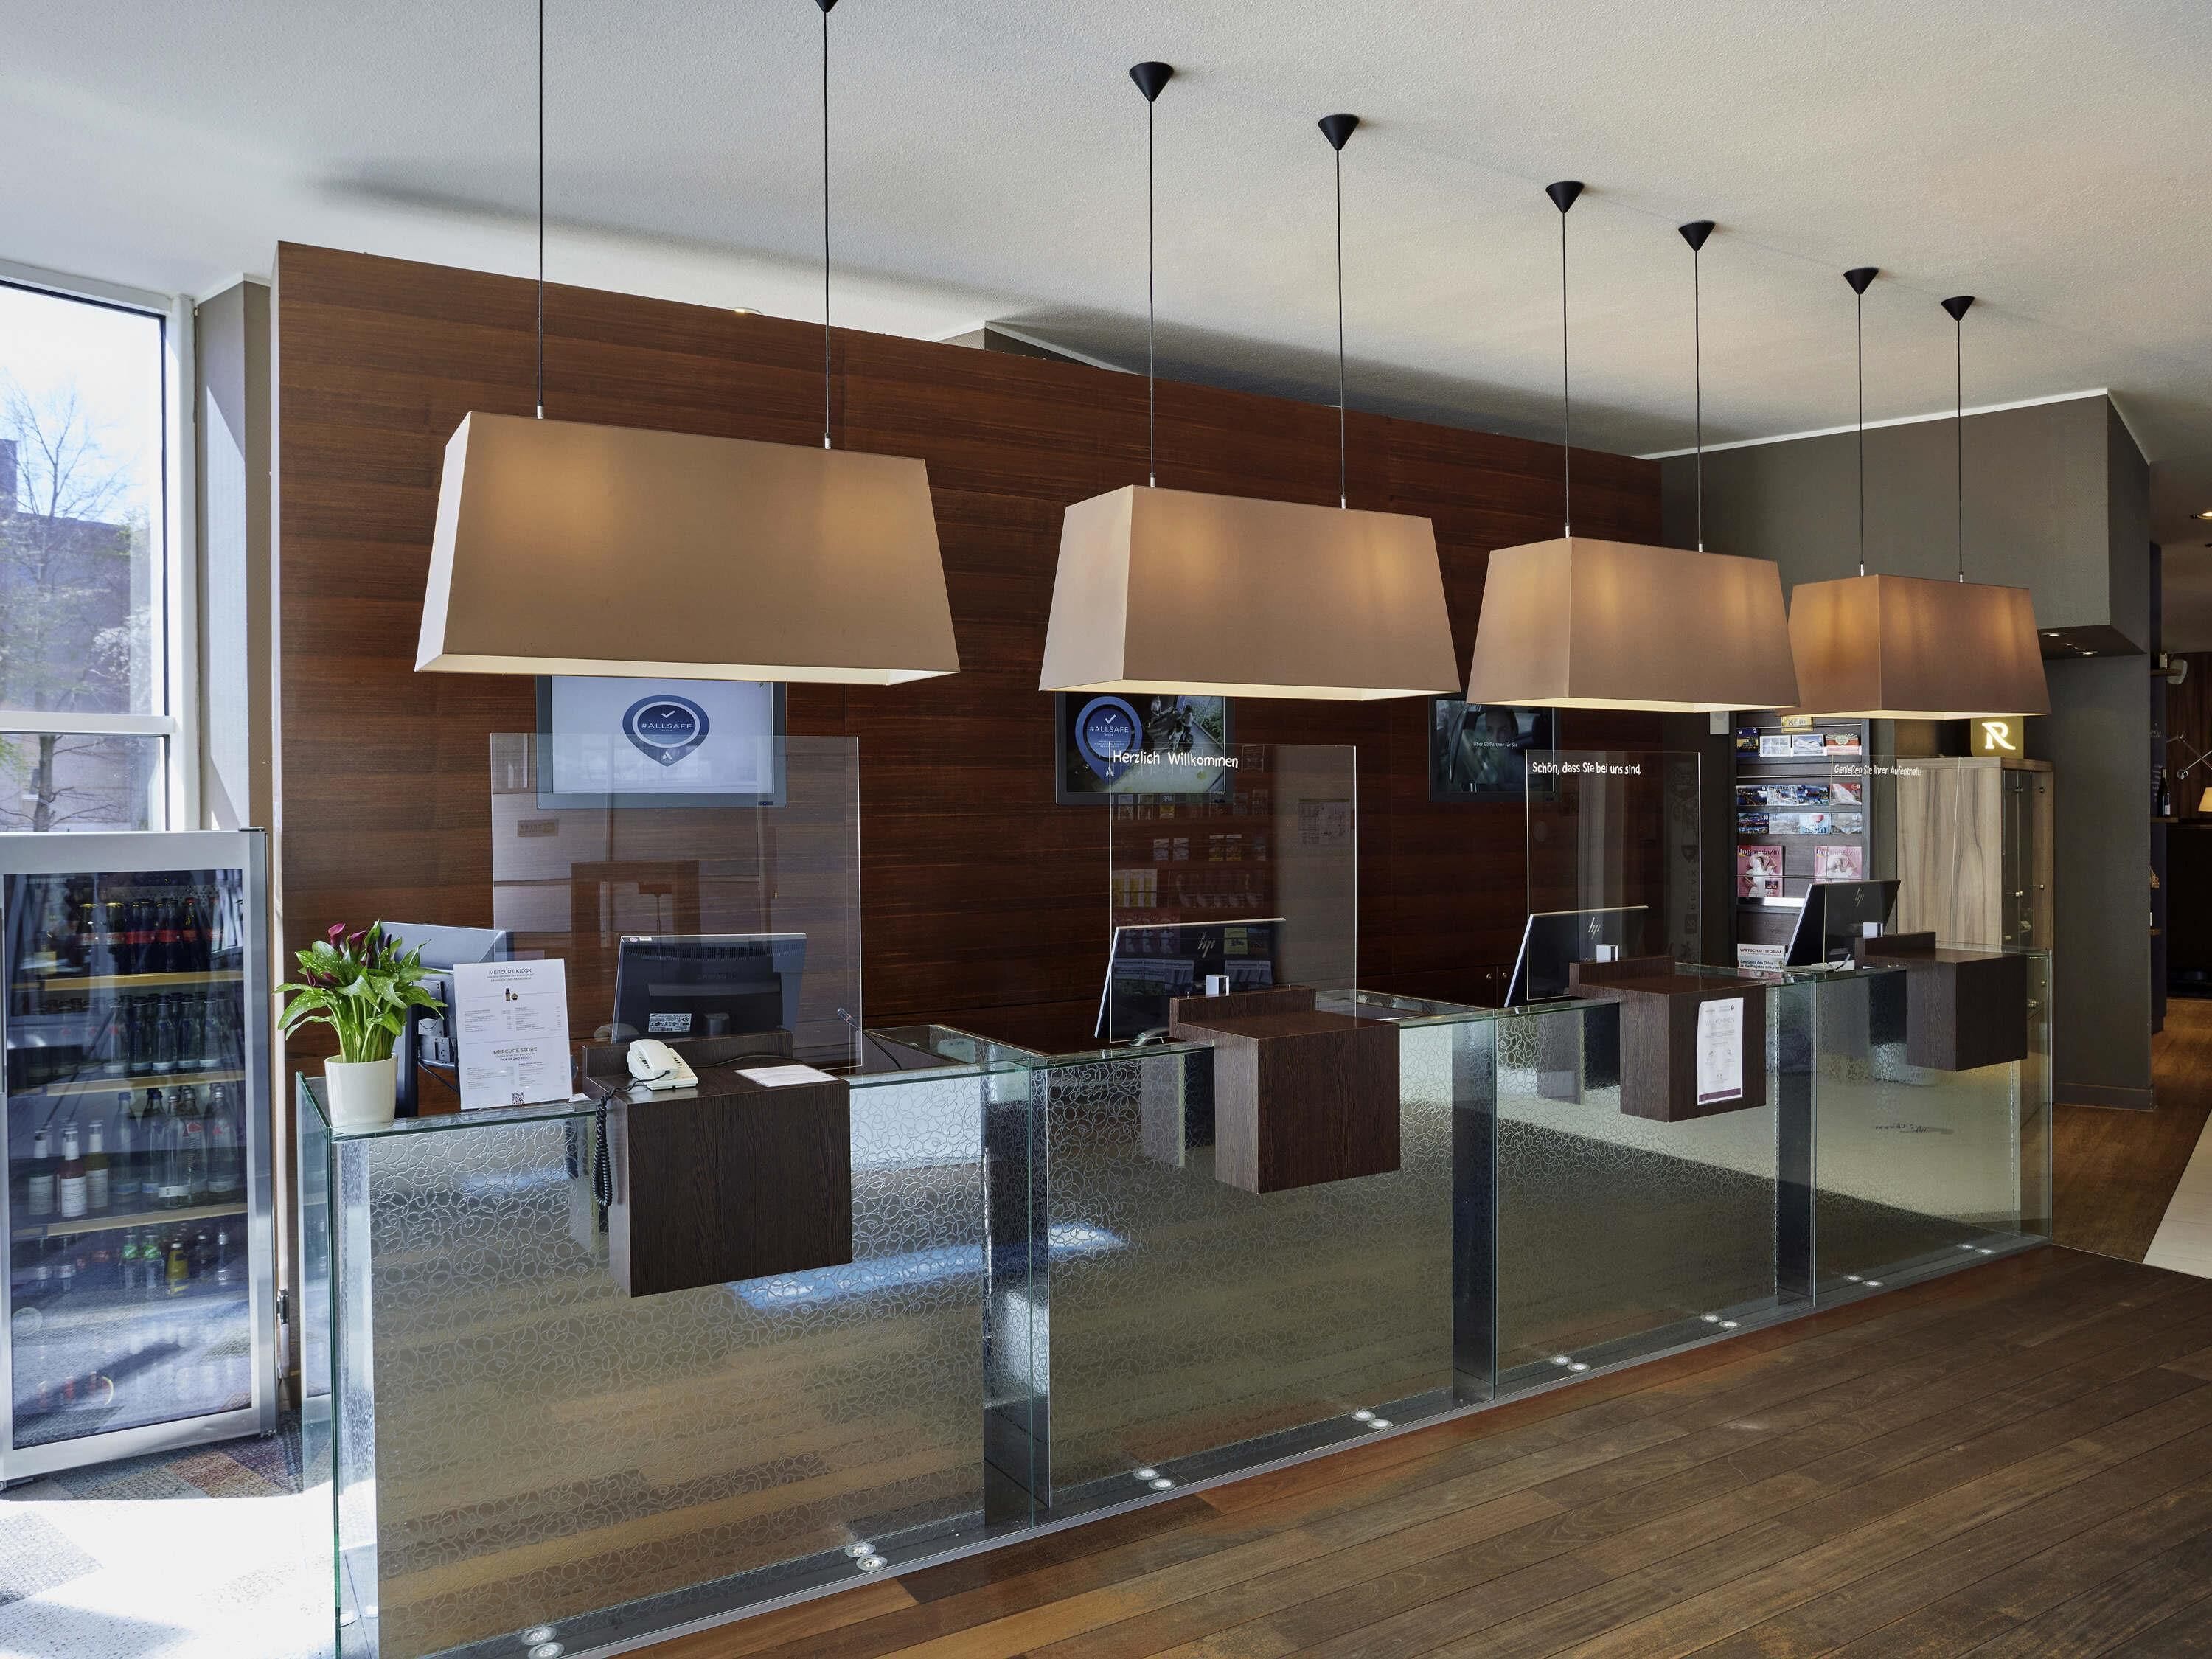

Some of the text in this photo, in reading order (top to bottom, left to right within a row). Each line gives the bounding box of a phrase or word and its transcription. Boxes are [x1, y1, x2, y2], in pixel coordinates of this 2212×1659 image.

[1982, 721, 2016, 750] R
[1113, 750, 1239, 769] Herzlich Willkommen
[1532, 762, 1560, 775] Schön,
[1562, 762, 1581, 773] dass
[1582, 762, 1595, 773] Sie
[1596, 762, 1608, 773] bei
[1610, 764, 1623, 774] uns
[1834, 764, 1863, 775] Genießen
[1863, 765, 1873, 775] Sie
[1874, 764, 1890, 775] Ihren
